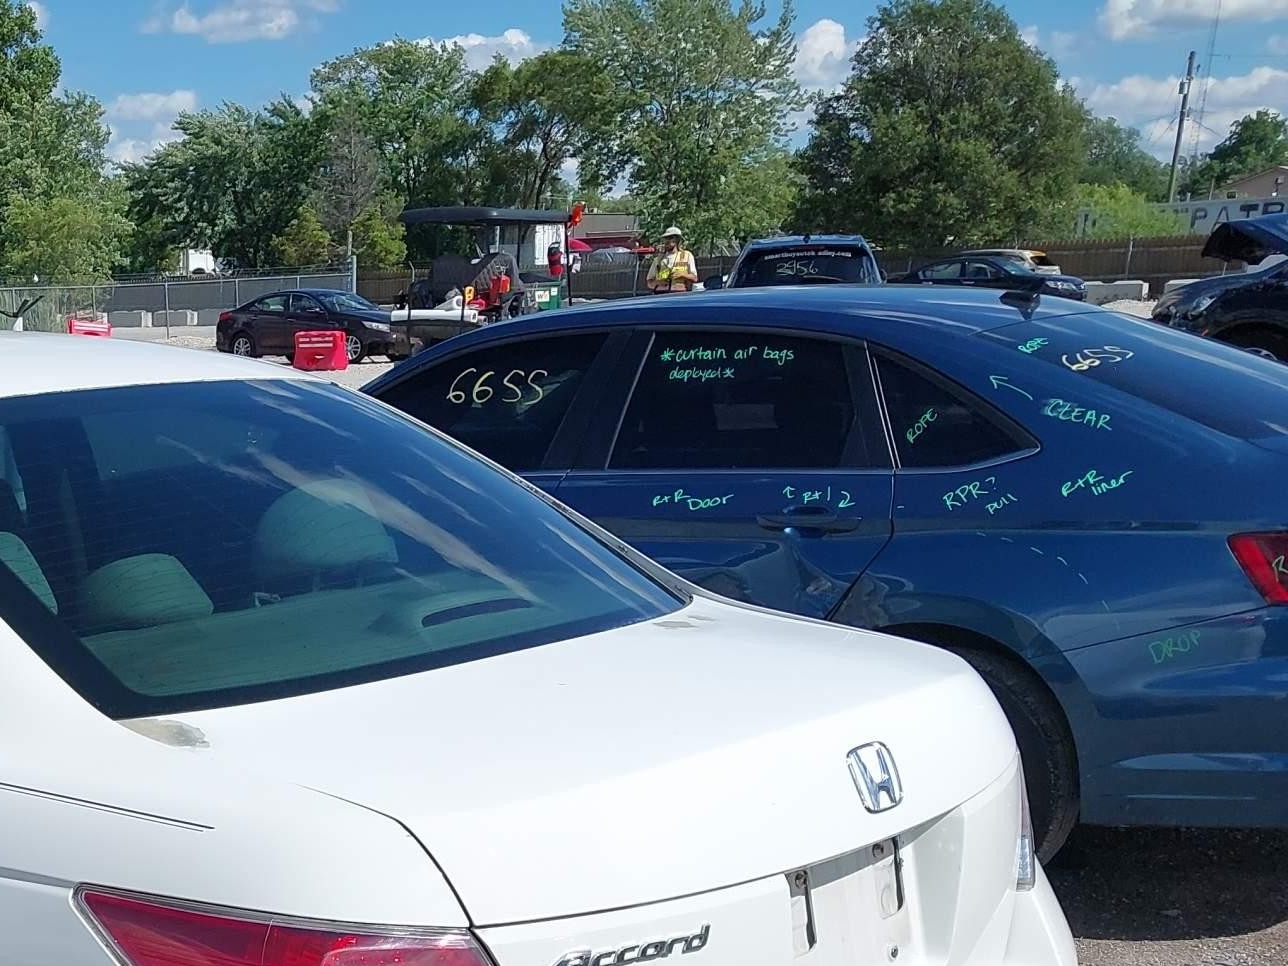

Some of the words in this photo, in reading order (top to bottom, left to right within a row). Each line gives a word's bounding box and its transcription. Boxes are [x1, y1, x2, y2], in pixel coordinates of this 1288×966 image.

[734, 346, 758, 360] air
[763, 346, 794, 366] bags
[906, 408, 938, 444] ROPE
[1148, 630, 1201, 665] DROP
